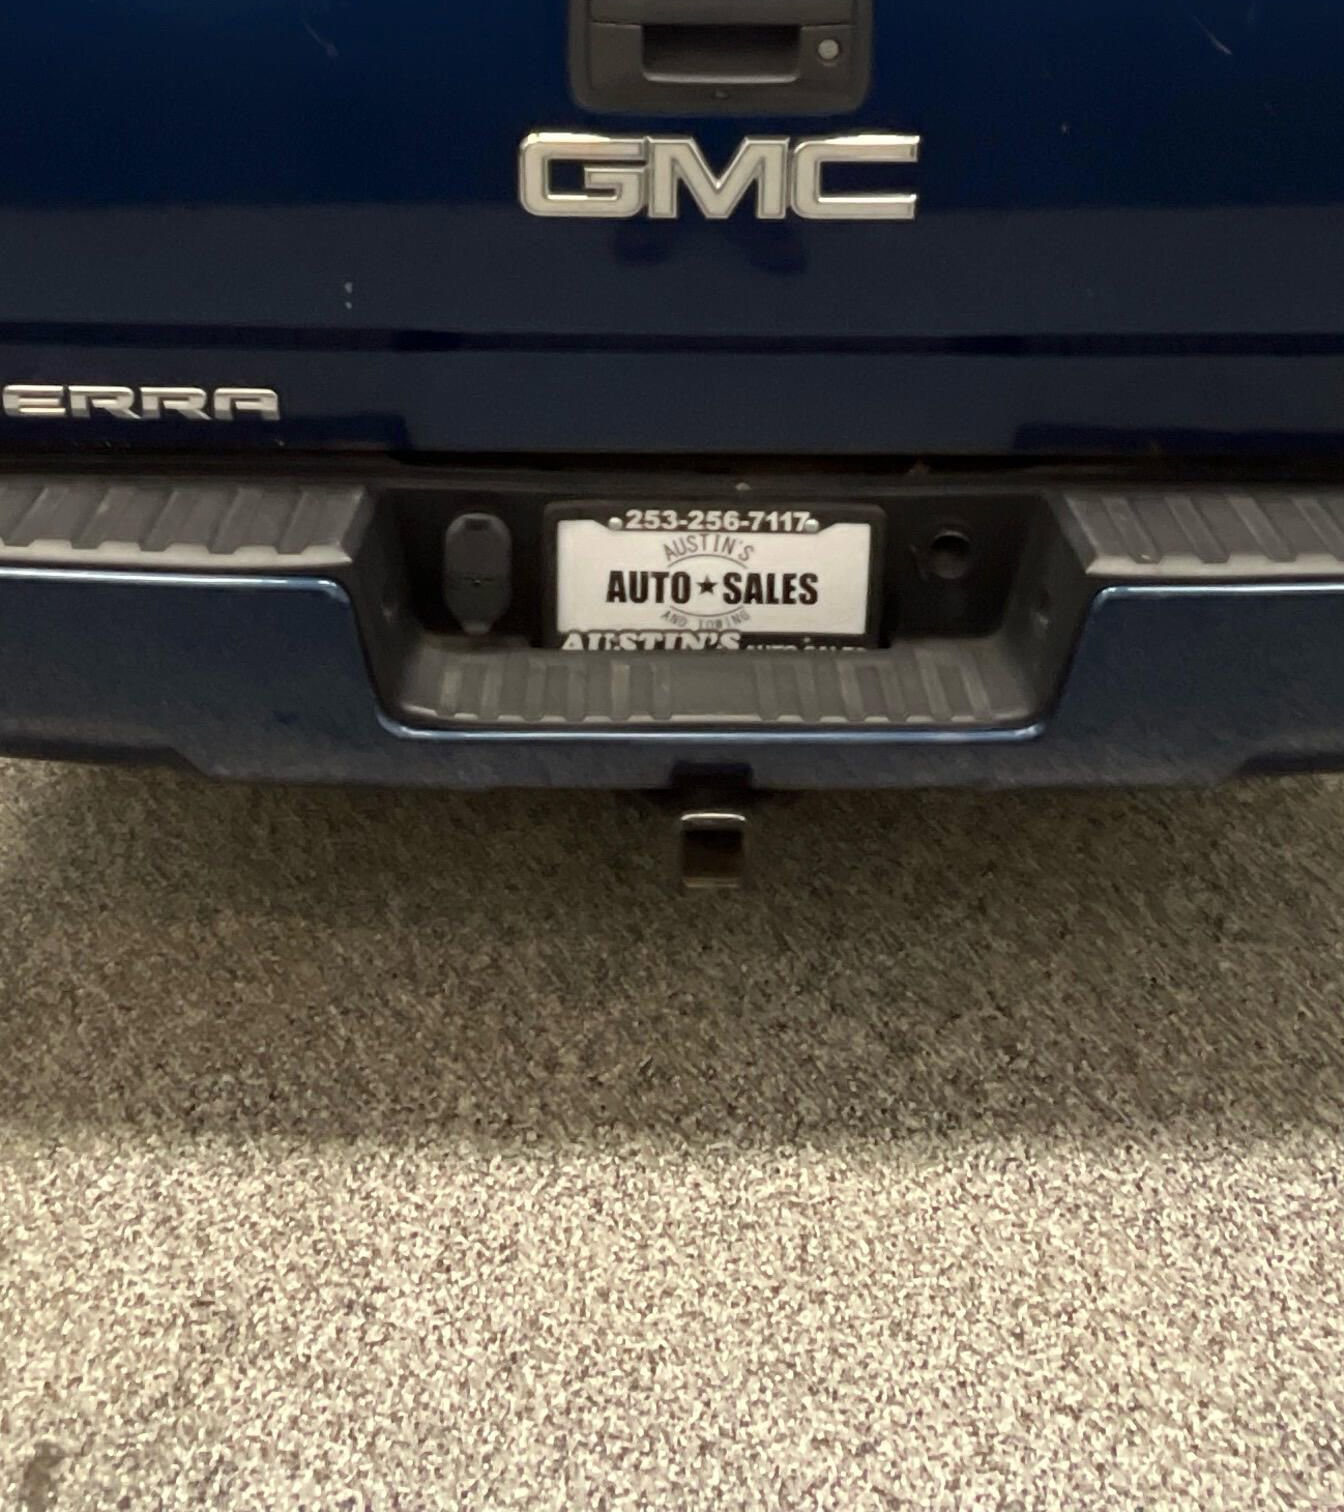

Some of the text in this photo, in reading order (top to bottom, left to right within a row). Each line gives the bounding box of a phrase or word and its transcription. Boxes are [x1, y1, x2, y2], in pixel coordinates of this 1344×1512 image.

[519, 132, 920, 220] GMC
[625, 509, 810, 532] 253-256-7117
[662, 533, 755, 563] AUSTIN'S
[606, 570, 818, 605] AUTO SALES
